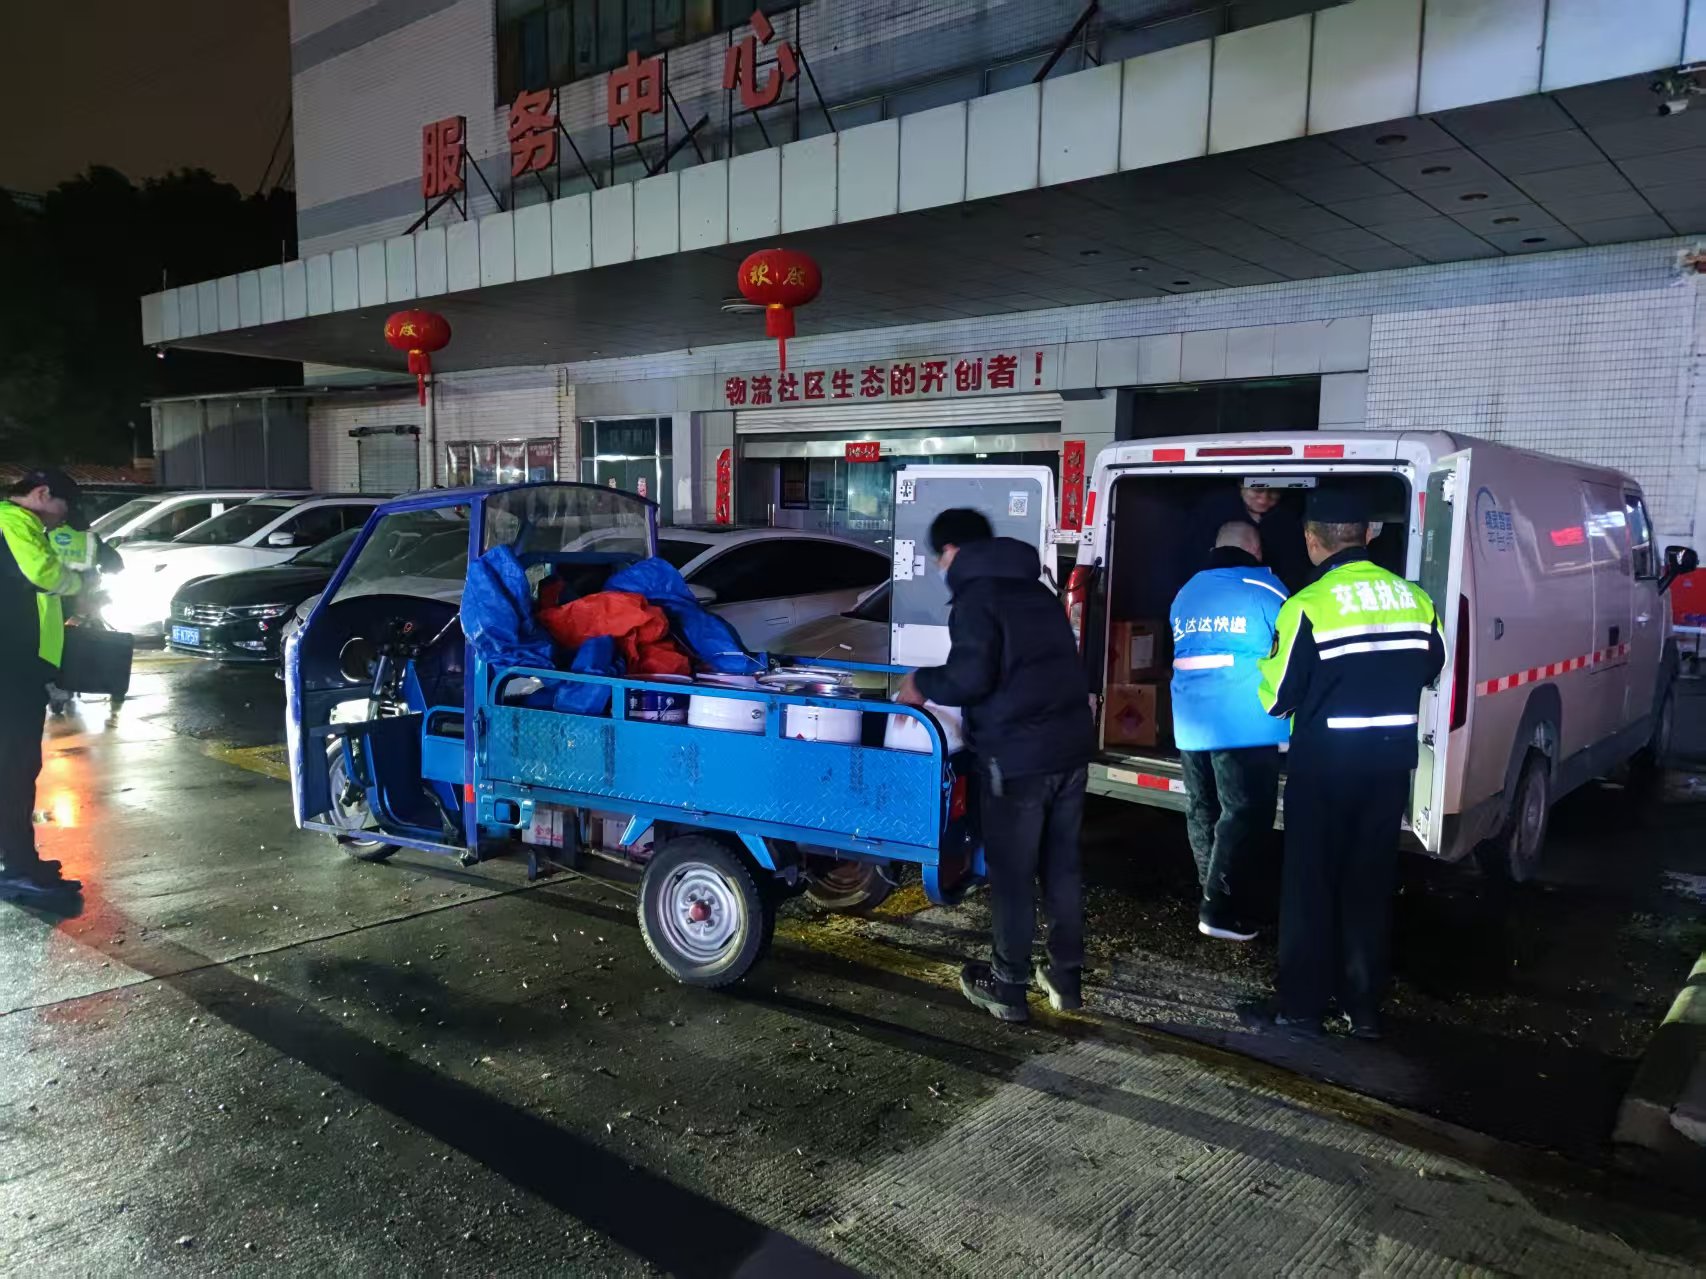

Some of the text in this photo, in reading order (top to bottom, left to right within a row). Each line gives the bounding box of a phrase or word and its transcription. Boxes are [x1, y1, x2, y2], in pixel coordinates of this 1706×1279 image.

[422, 9, 799, 199] 服务中心
[726, 352, 1043, 405] 物流社区生态的开创者！
[1330, 579, 1417, 616] 交通执法
